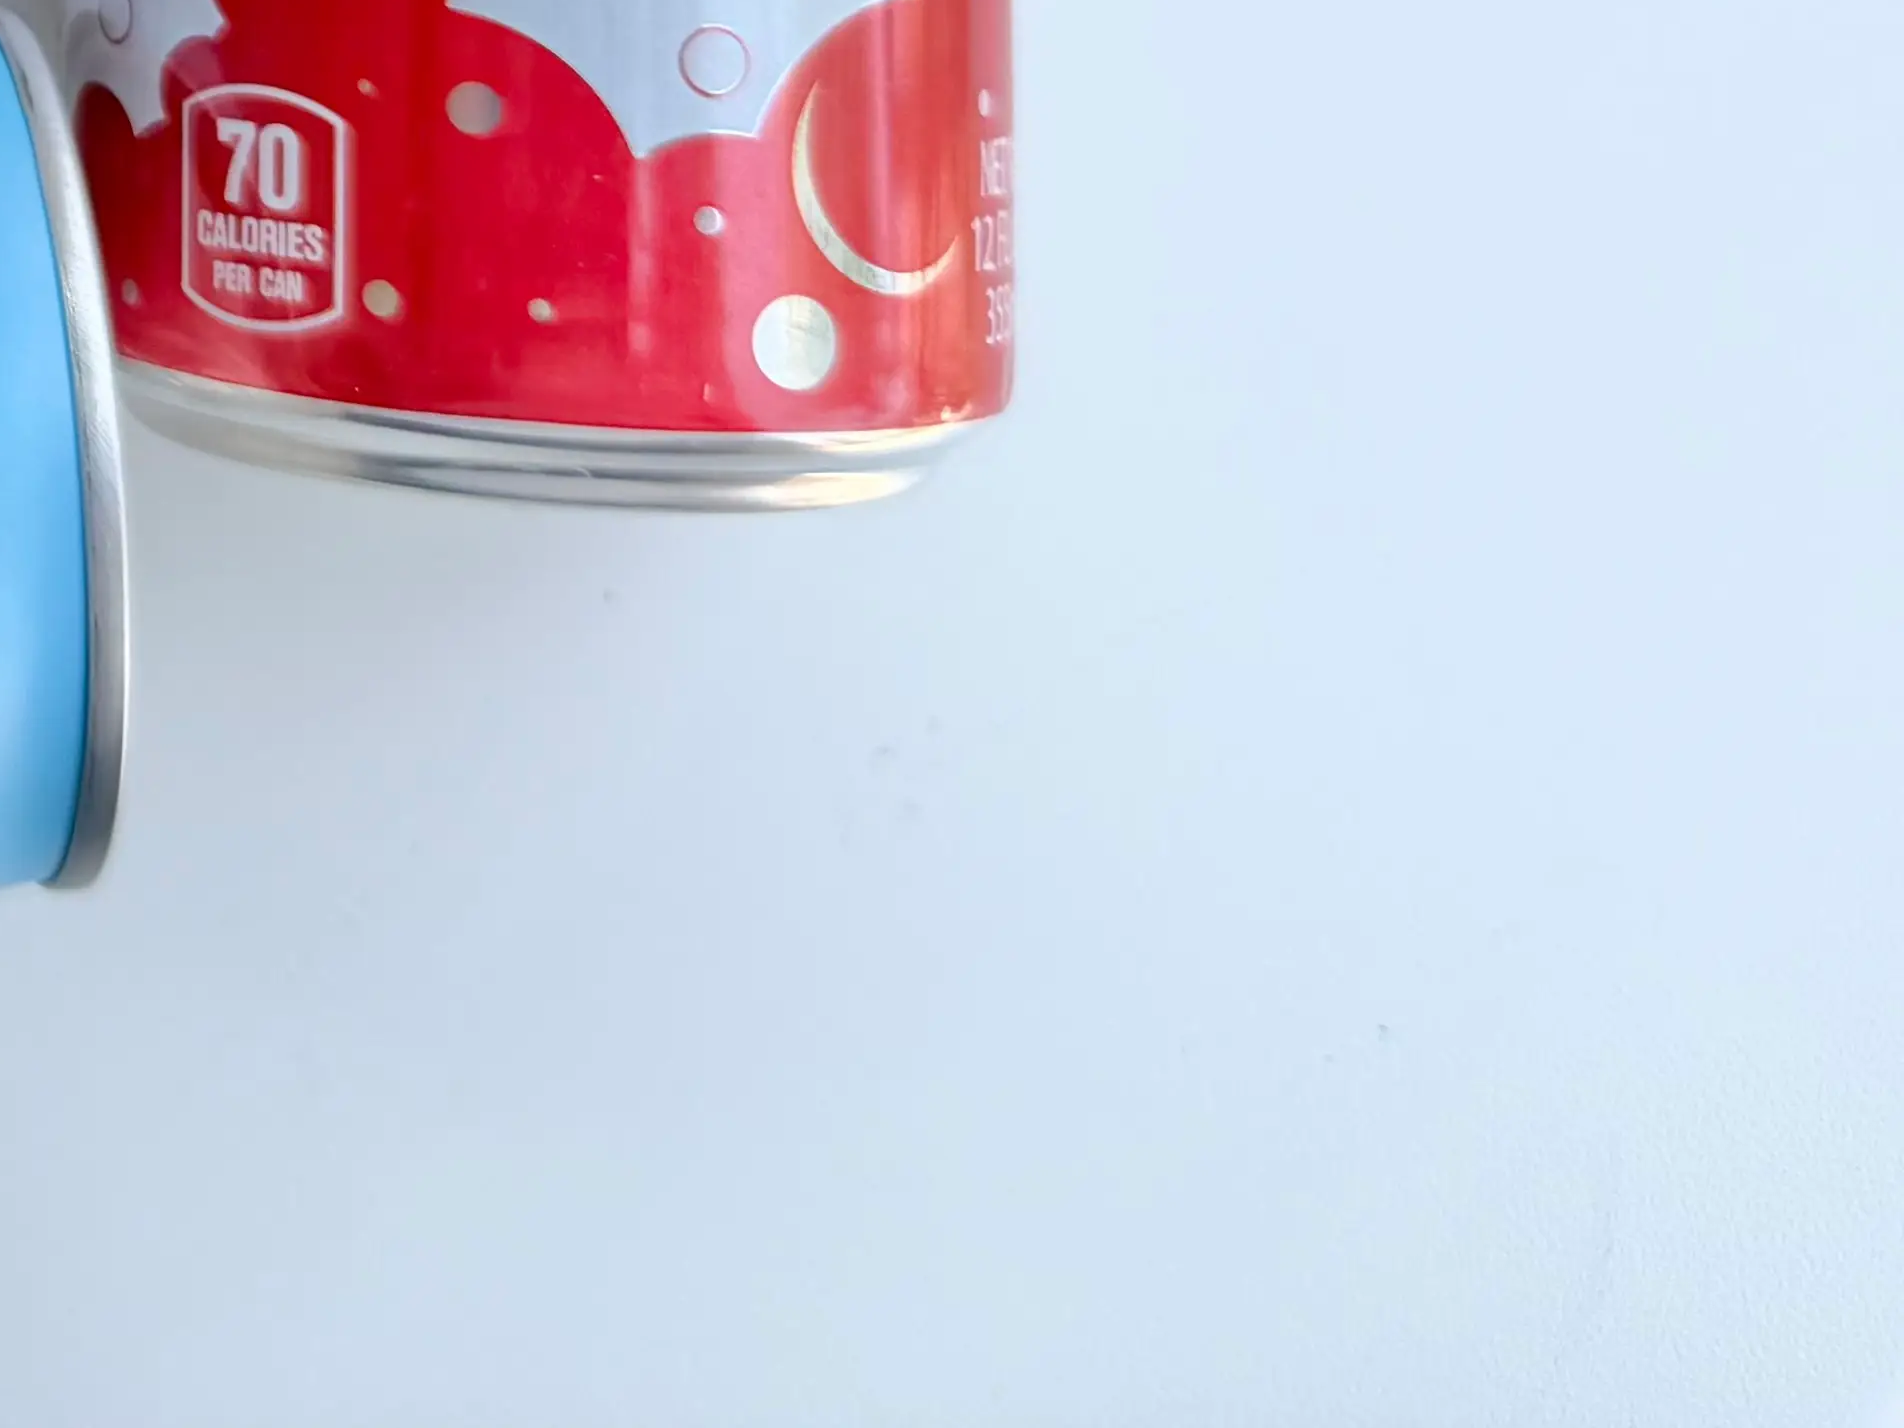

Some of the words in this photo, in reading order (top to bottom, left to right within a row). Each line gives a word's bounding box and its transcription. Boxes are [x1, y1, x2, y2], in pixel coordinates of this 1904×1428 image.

[215, 120, 301, 212] 70
[196, 207, 325, 265] CALORIES
[211, 258, 256, 299] PER
[259, 262, 305, 305] CAN
